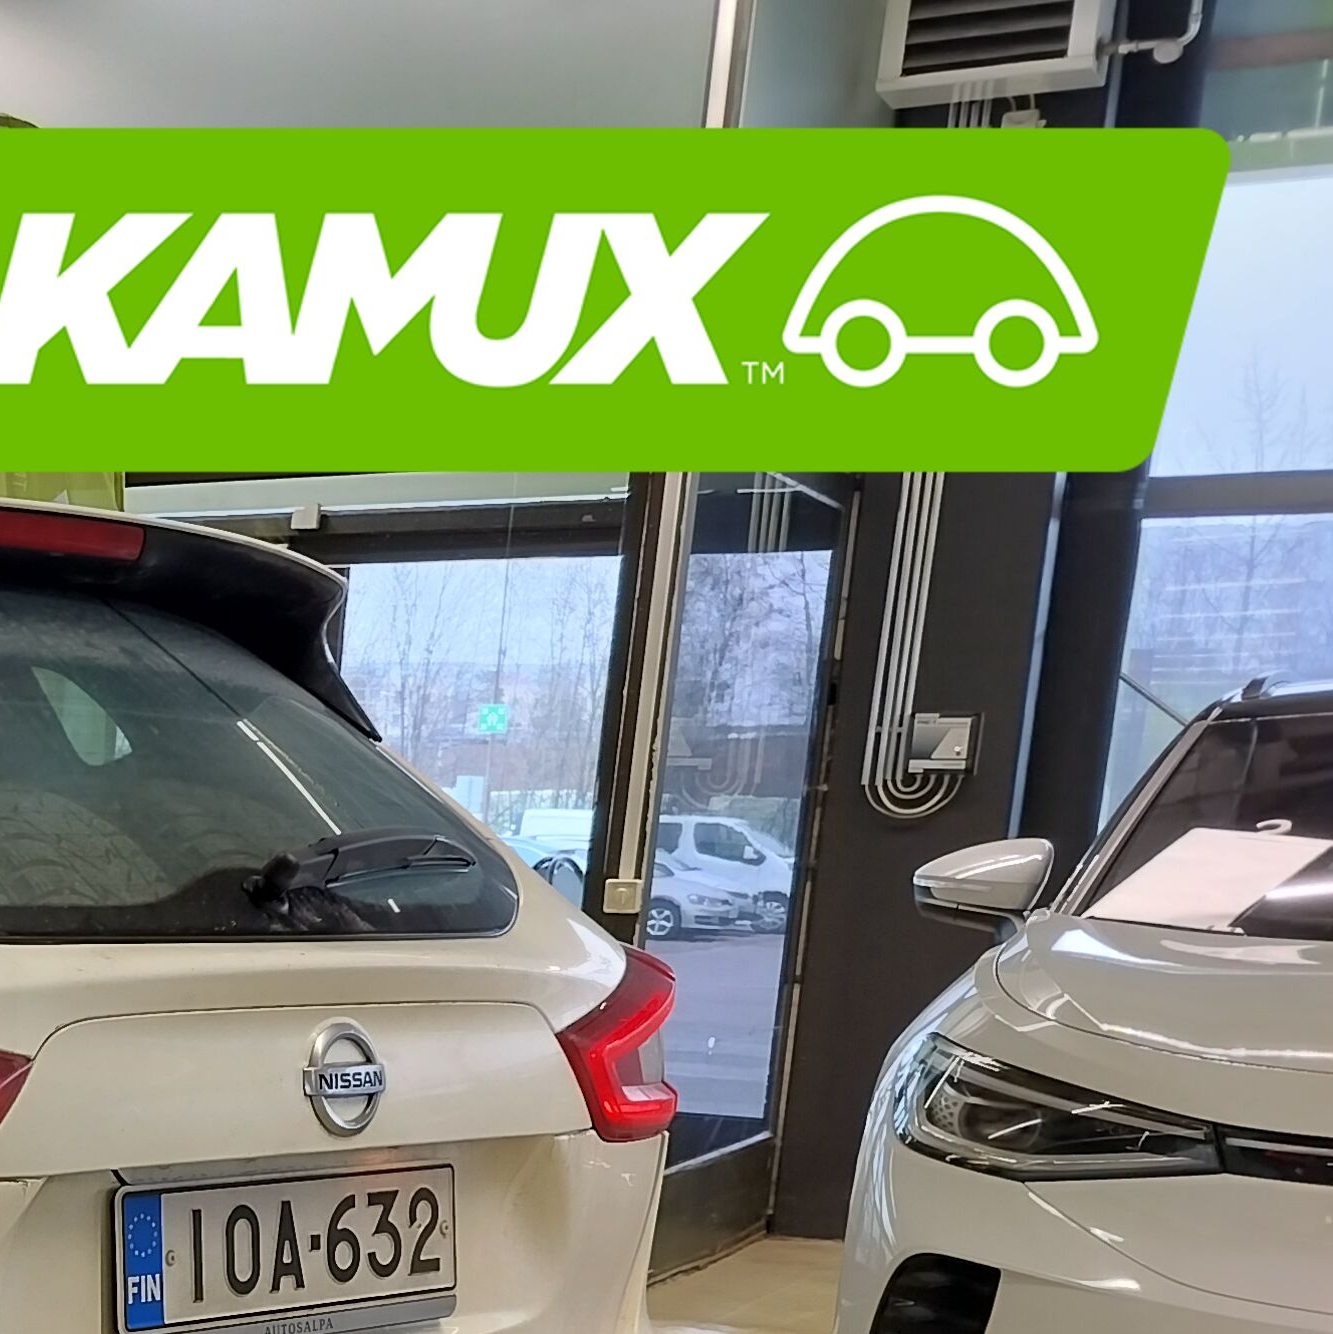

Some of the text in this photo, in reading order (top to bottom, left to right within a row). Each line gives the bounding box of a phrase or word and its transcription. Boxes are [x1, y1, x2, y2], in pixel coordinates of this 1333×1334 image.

[318, 1071, 383, 1090] NISSAN
[191, 1187, 441, 1303] IOA-632
[127, 1274, 161, 1304] FIN
